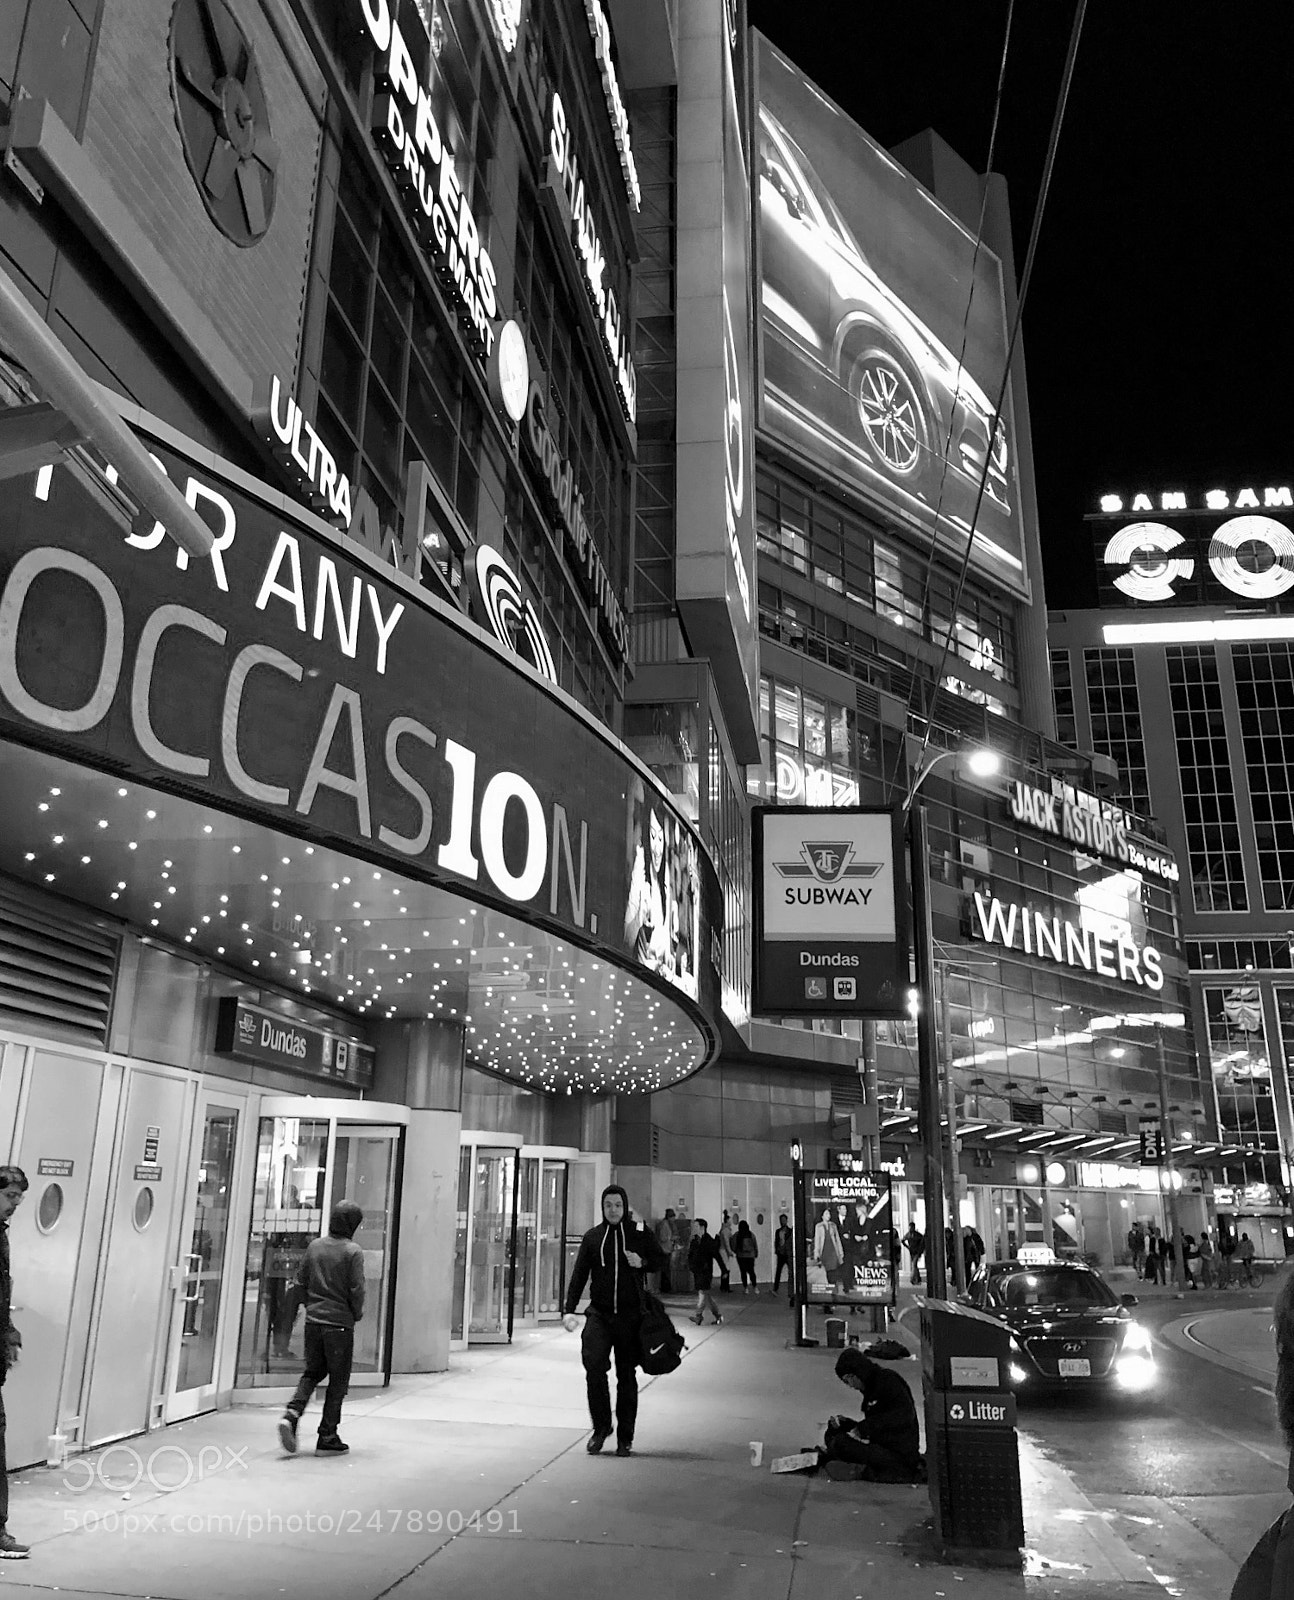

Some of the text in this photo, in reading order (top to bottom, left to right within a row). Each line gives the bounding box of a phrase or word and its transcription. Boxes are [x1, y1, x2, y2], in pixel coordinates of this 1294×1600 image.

[387, 94, 495, 357] DRUG MART
[270, 374, 353, 529] ULTRA
[1100, 486, 1294, 512] SAM SAM
[254, 530, 406, 676] ANY
[1012, 780, 1061, 835] JACK
[784, 887, 873, 905] SUBWAY
[973, 890, 1165, 992] WINNERS
[800, 951, 860, 967] Dundas
[260, 1018, 307, 1059] Dundas
[839, 1177, 877, 1187] LOCAL.
[854, 1265, 888, 1278] NEWS
[968, 1401, 1006, 1421] Litter
